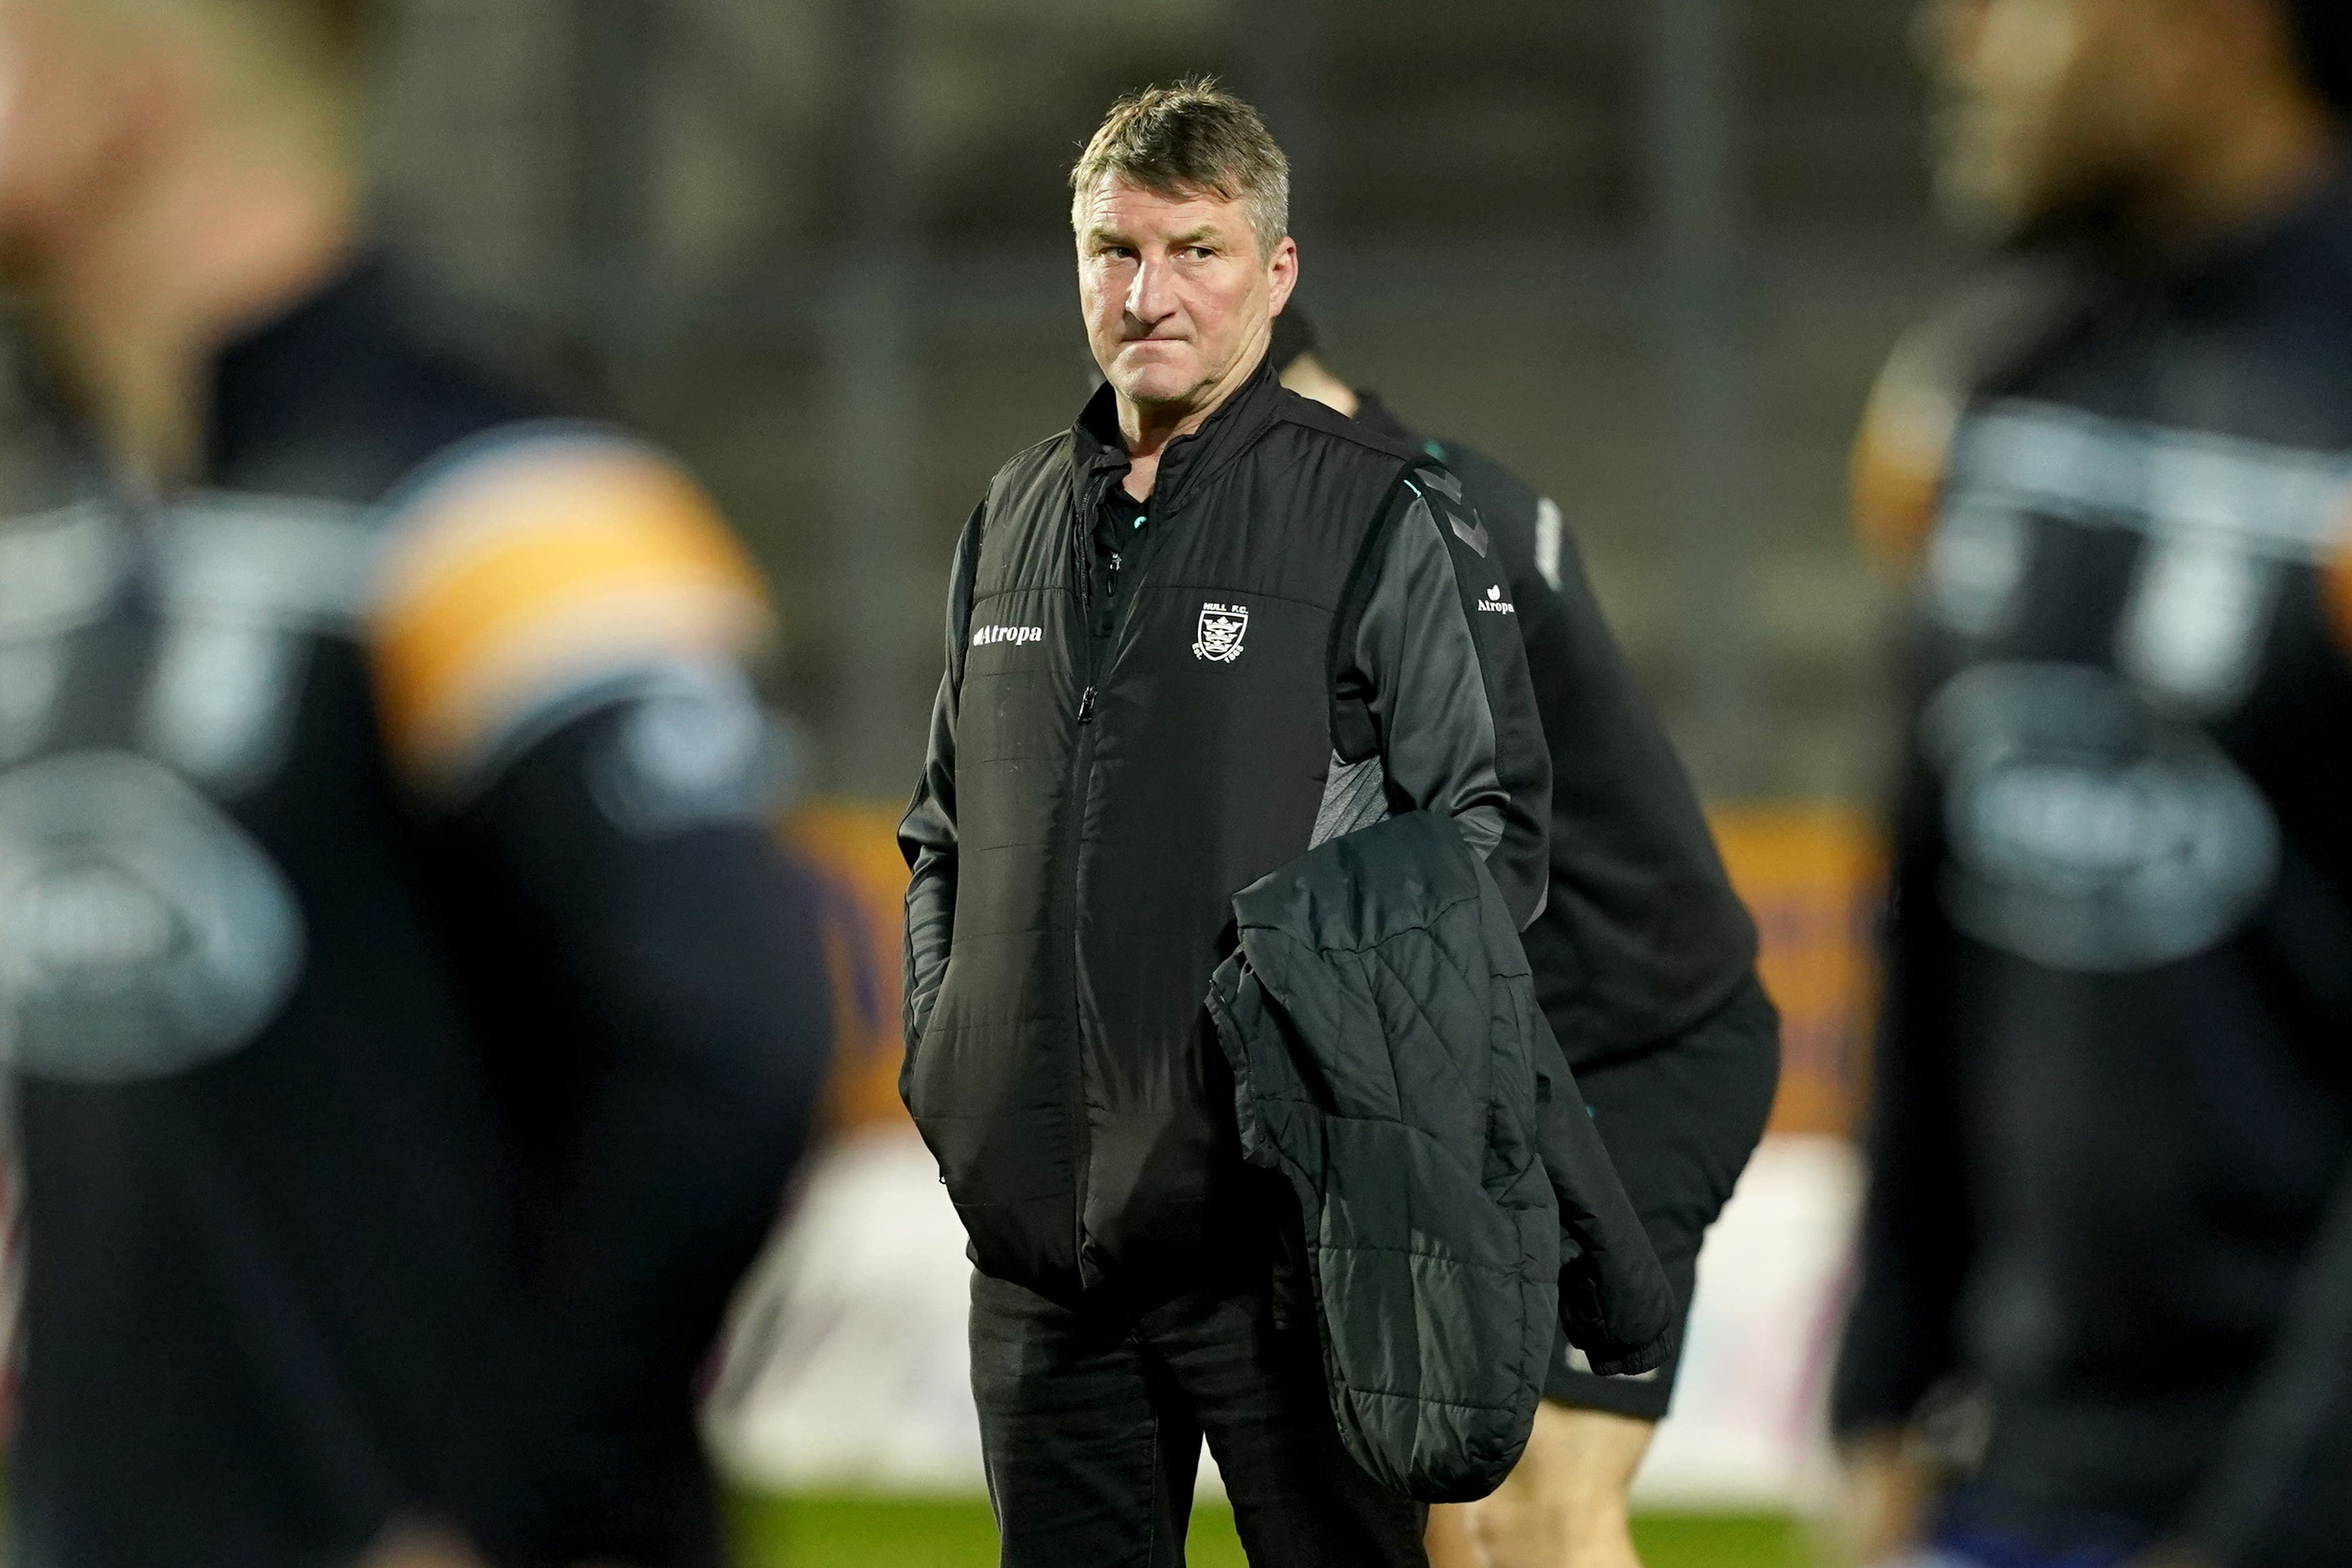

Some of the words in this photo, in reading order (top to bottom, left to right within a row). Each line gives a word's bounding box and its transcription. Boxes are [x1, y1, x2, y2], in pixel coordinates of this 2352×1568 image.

[1203, 603, 1226, 612] HULL
[1232, 605, 1249, 614] F.C.
[1477, 599, 1515, 614] Atropa
[978, 625, 1042, 645] Atropa
